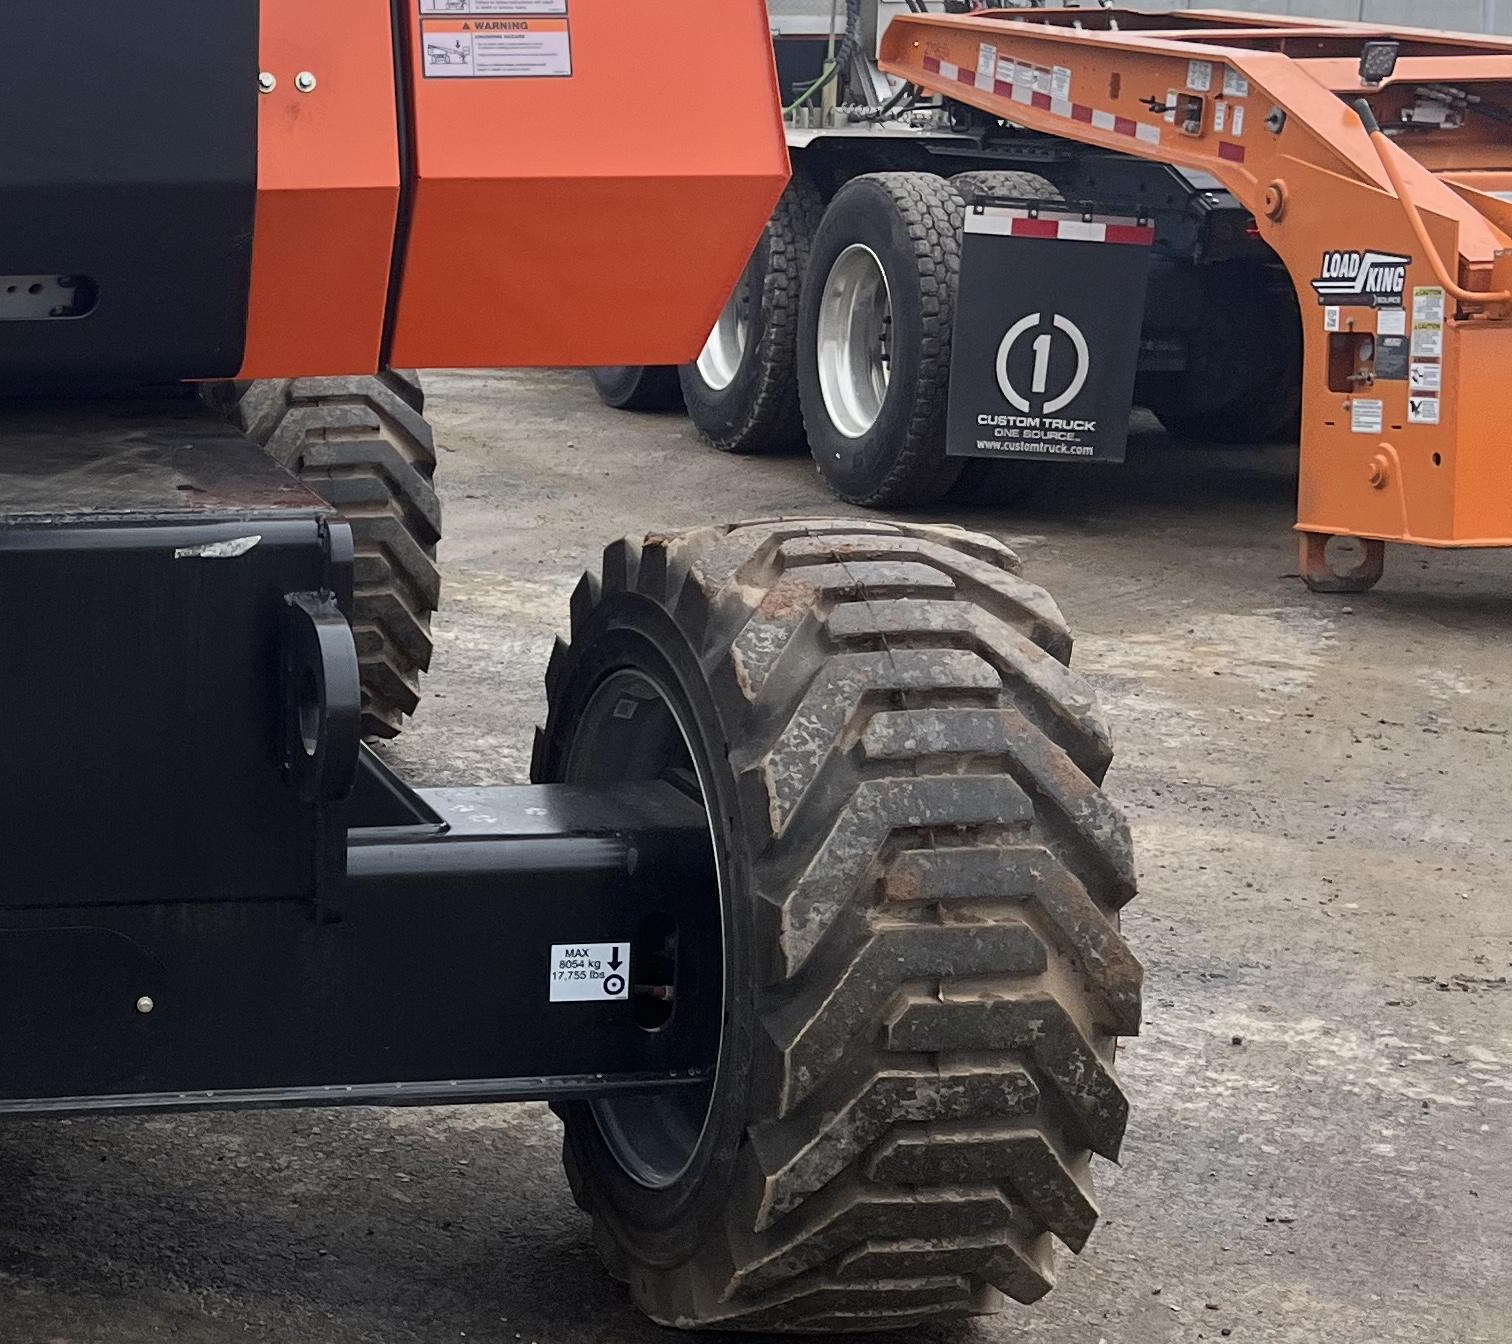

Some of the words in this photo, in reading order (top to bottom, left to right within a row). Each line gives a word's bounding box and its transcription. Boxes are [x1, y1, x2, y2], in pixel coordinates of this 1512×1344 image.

[474, 21, 529, 30] WARNING
[1322, 253, 1361, 278] LOAD
[1365, 266, 1405, 292] KING
[977, 414, 1040, 427] CUSTOM
[1042, 418, 1097, 431] TRUCK
[994, 428, 1020, 438] ONE
[976, 440, 1094, 455] www.customtruck.com
[565, 948, 590, 958] MAX
[559, 959, 585, 969] 8054
[588, 959, 601, 970] kg
[589, 970, 605, 979] lbs
